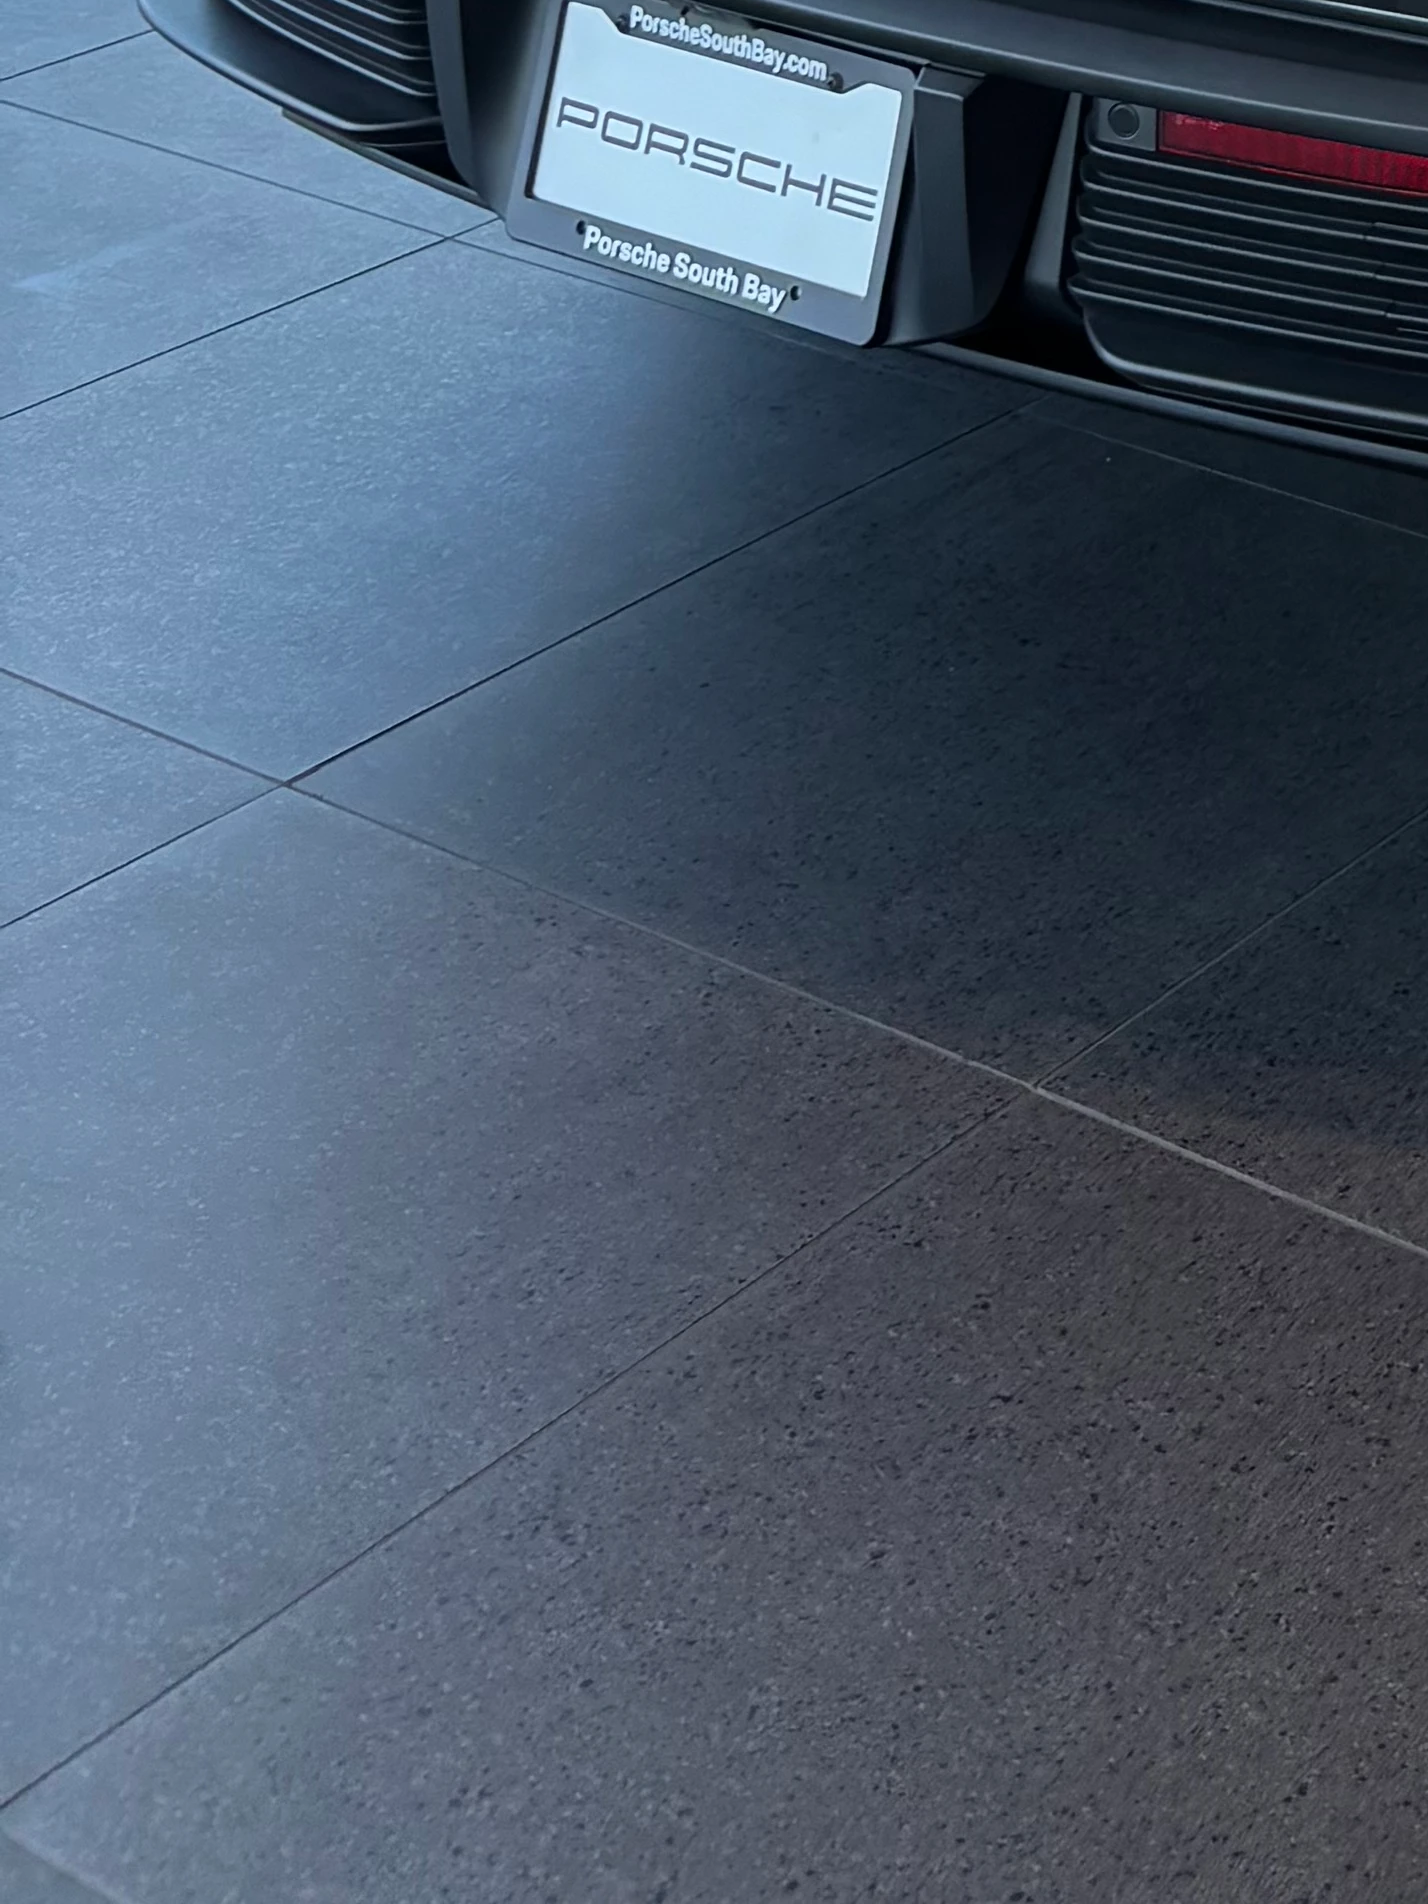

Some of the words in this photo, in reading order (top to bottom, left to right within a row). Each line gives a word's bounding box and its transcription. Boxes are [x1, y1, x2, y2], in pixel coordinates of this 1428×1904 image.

[629, 4, 829, 82] PorscheSouthBay.com
[555, 96, 879, 222] PORSCHE
[582, 224, 671, 274] Porsche
[672, 252, 740, 296] South
[742, 272, 788, 314] Bay
